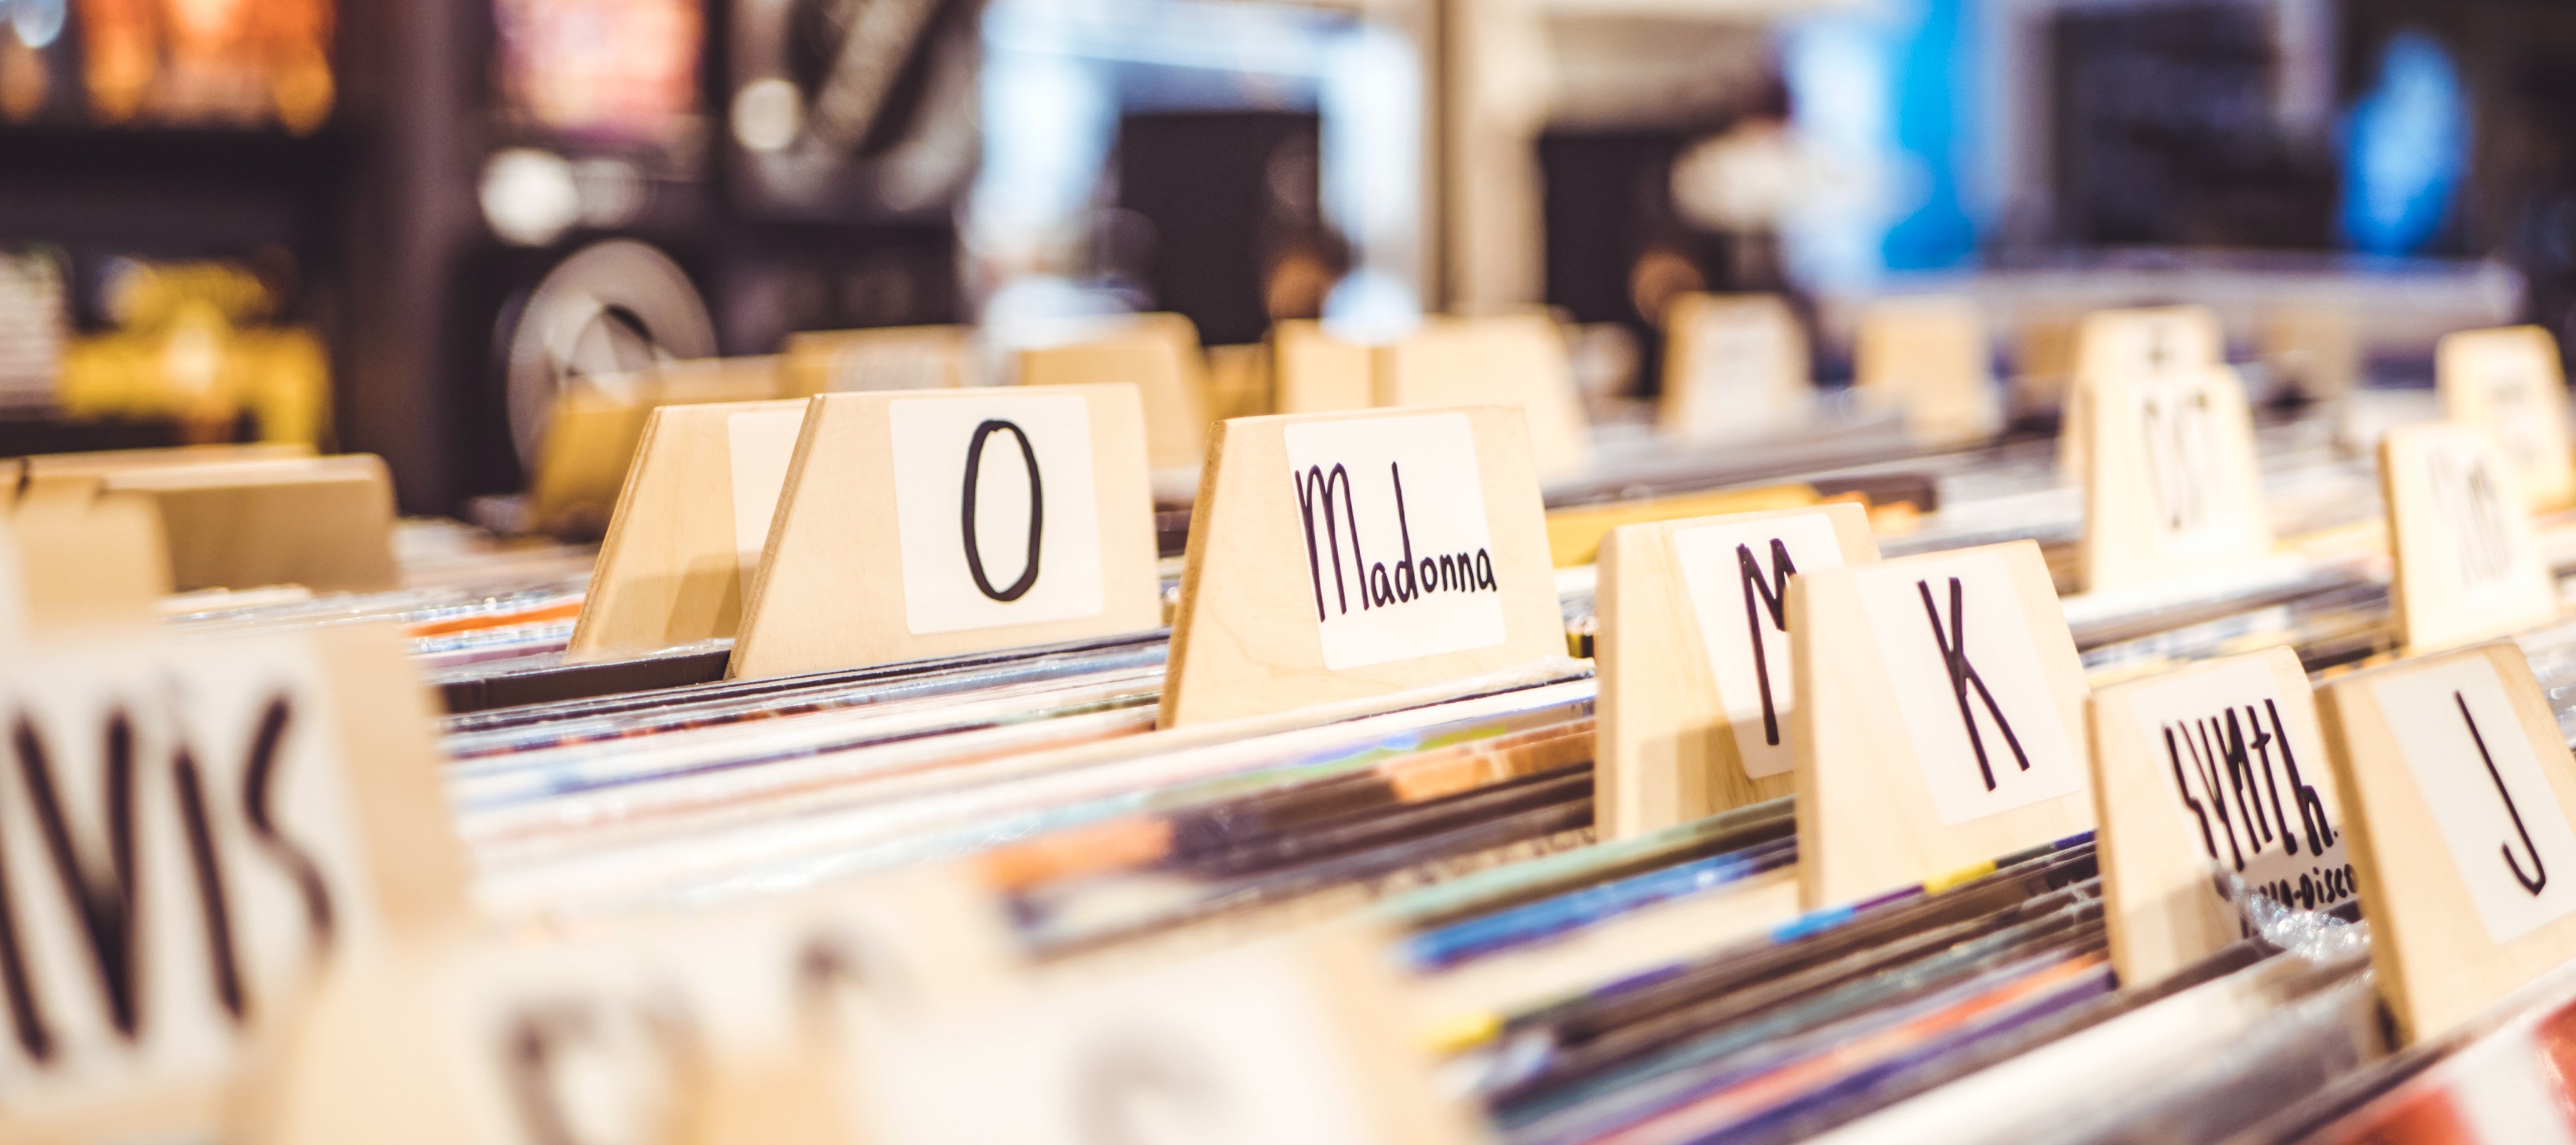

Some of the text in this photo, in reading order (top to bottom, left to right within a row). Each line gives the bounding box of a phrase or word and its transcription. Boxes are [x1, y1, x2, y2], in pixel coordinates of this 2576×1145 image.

[1294, 461, 1497, 622] Madonna
[1917, 577, 2030, 792] K
[2454, 691, 2546, 896] J
